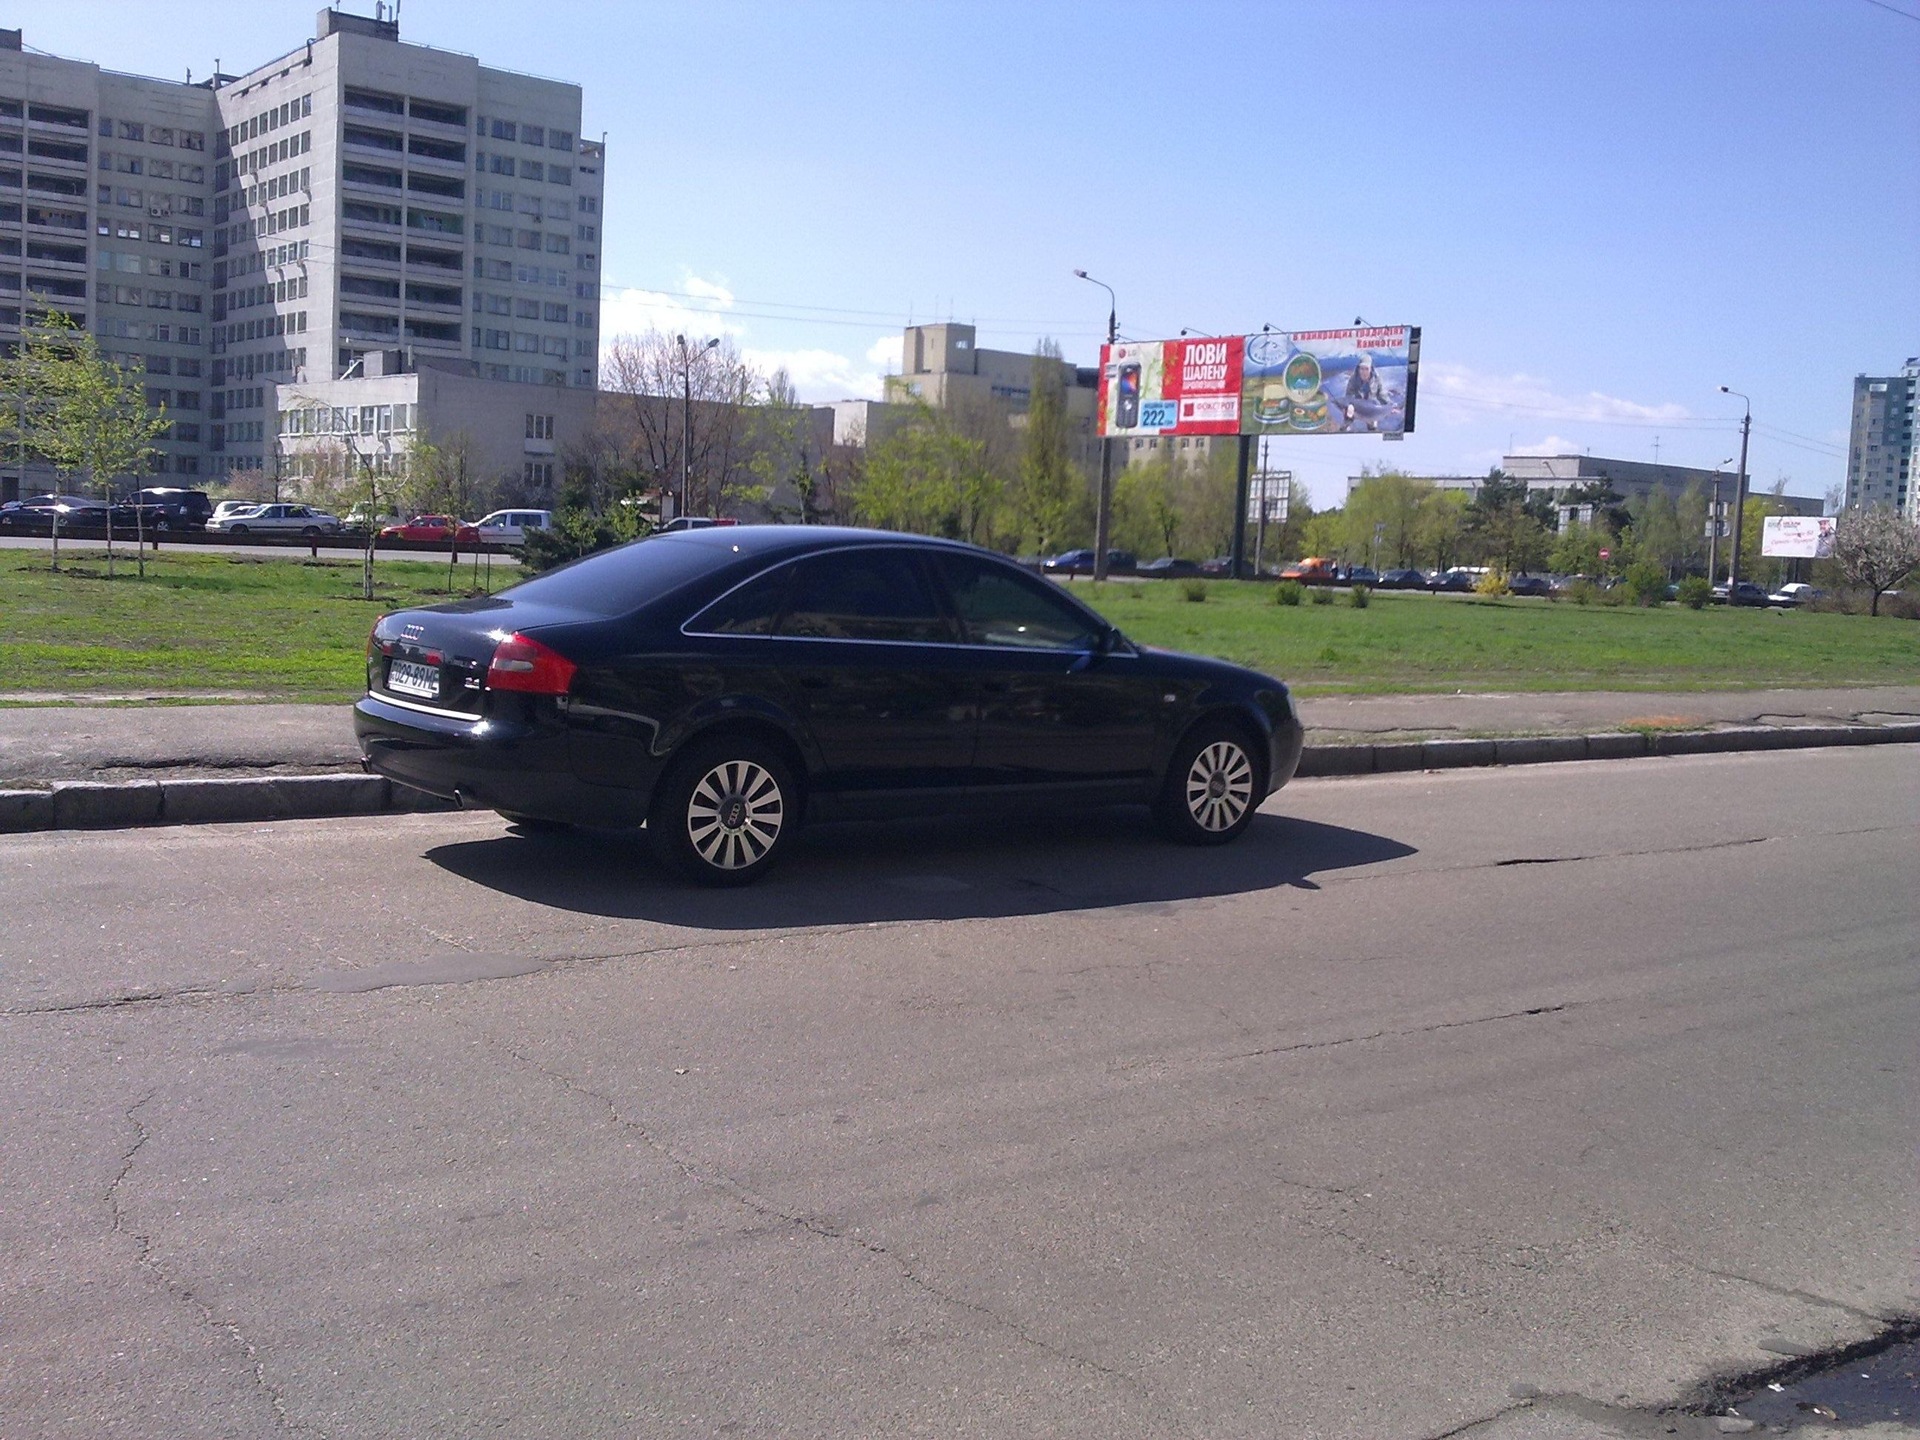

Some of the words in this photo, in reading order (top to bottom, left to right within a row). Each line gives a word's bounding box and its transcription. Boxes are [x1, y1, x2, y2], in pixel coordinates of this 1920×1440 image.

[1357, 339, 1403, 348] Камчатки
[1183, 343, 1227, 365] ЛОВИ
[1183, 365, 1229, 380] ШАЛЕНУ
[1196, 402, 1236, 410] ФОКСТРОТ
[1142, 410, 1165, 426] 222
